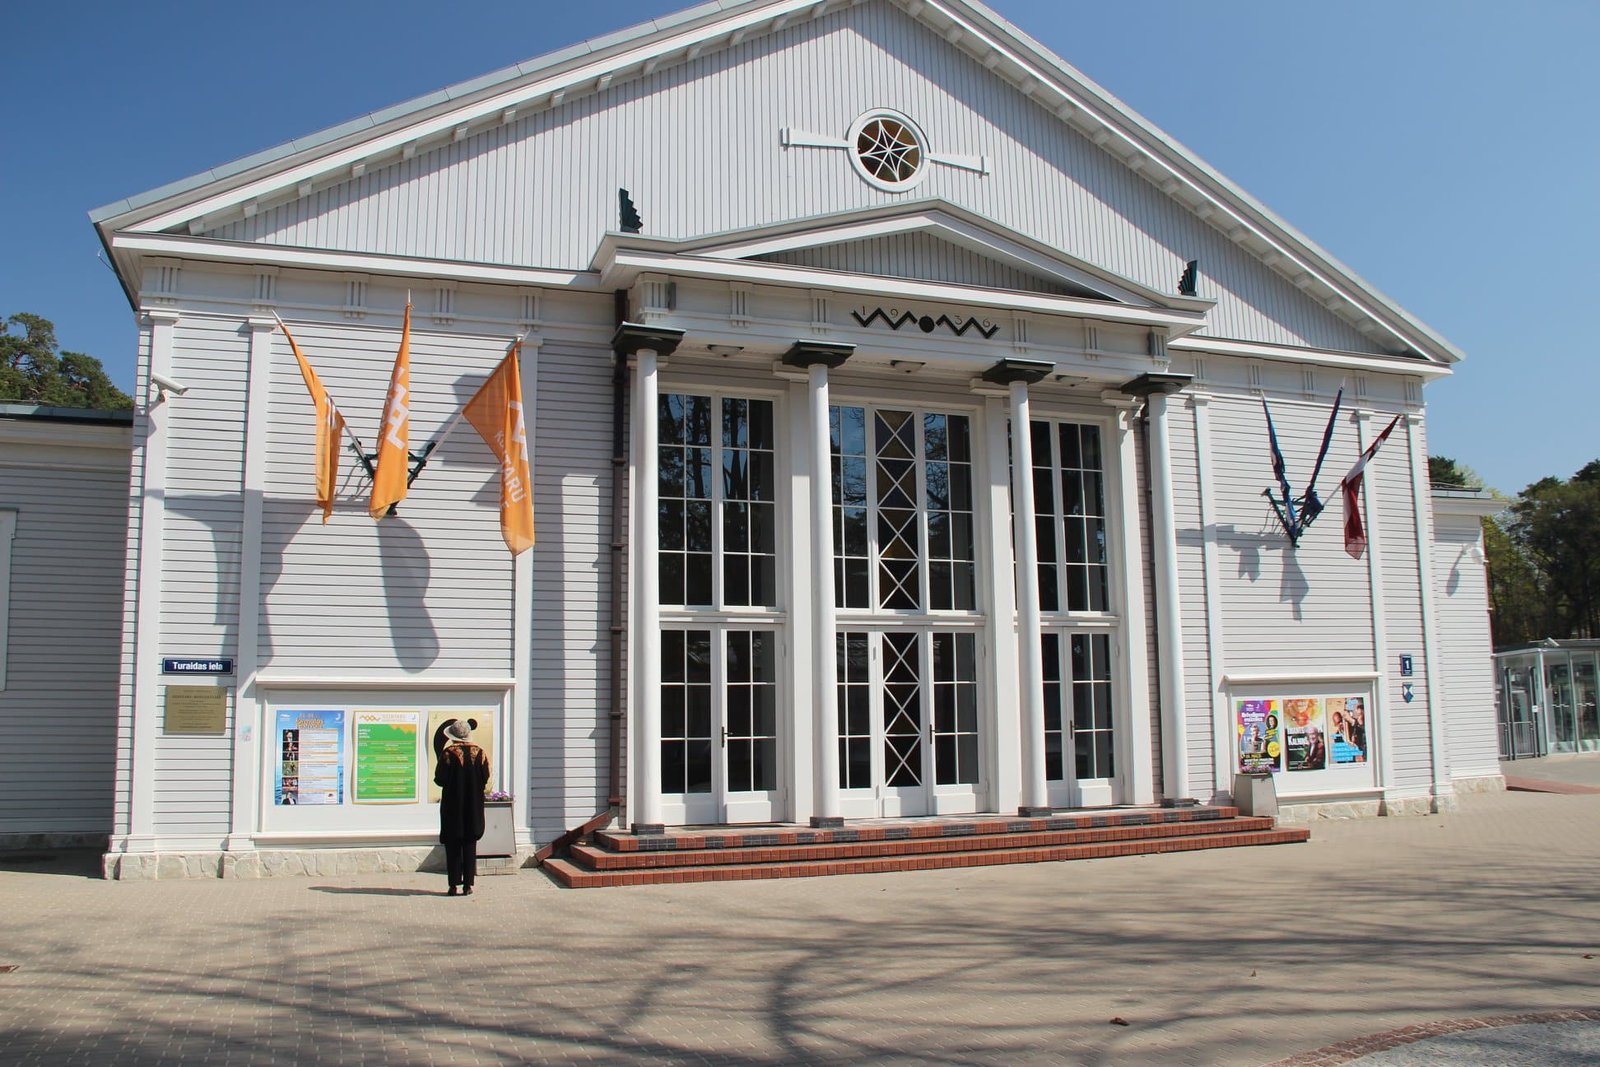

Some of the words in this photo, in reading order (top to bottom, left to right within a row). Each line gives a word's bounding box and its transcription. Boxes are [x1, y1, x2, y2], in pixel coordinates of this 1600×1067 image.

[172, 661, 207, 671] Turaidas
[208, 661, 224, 671] iela
[1404, 660, 1411, 670] 1
